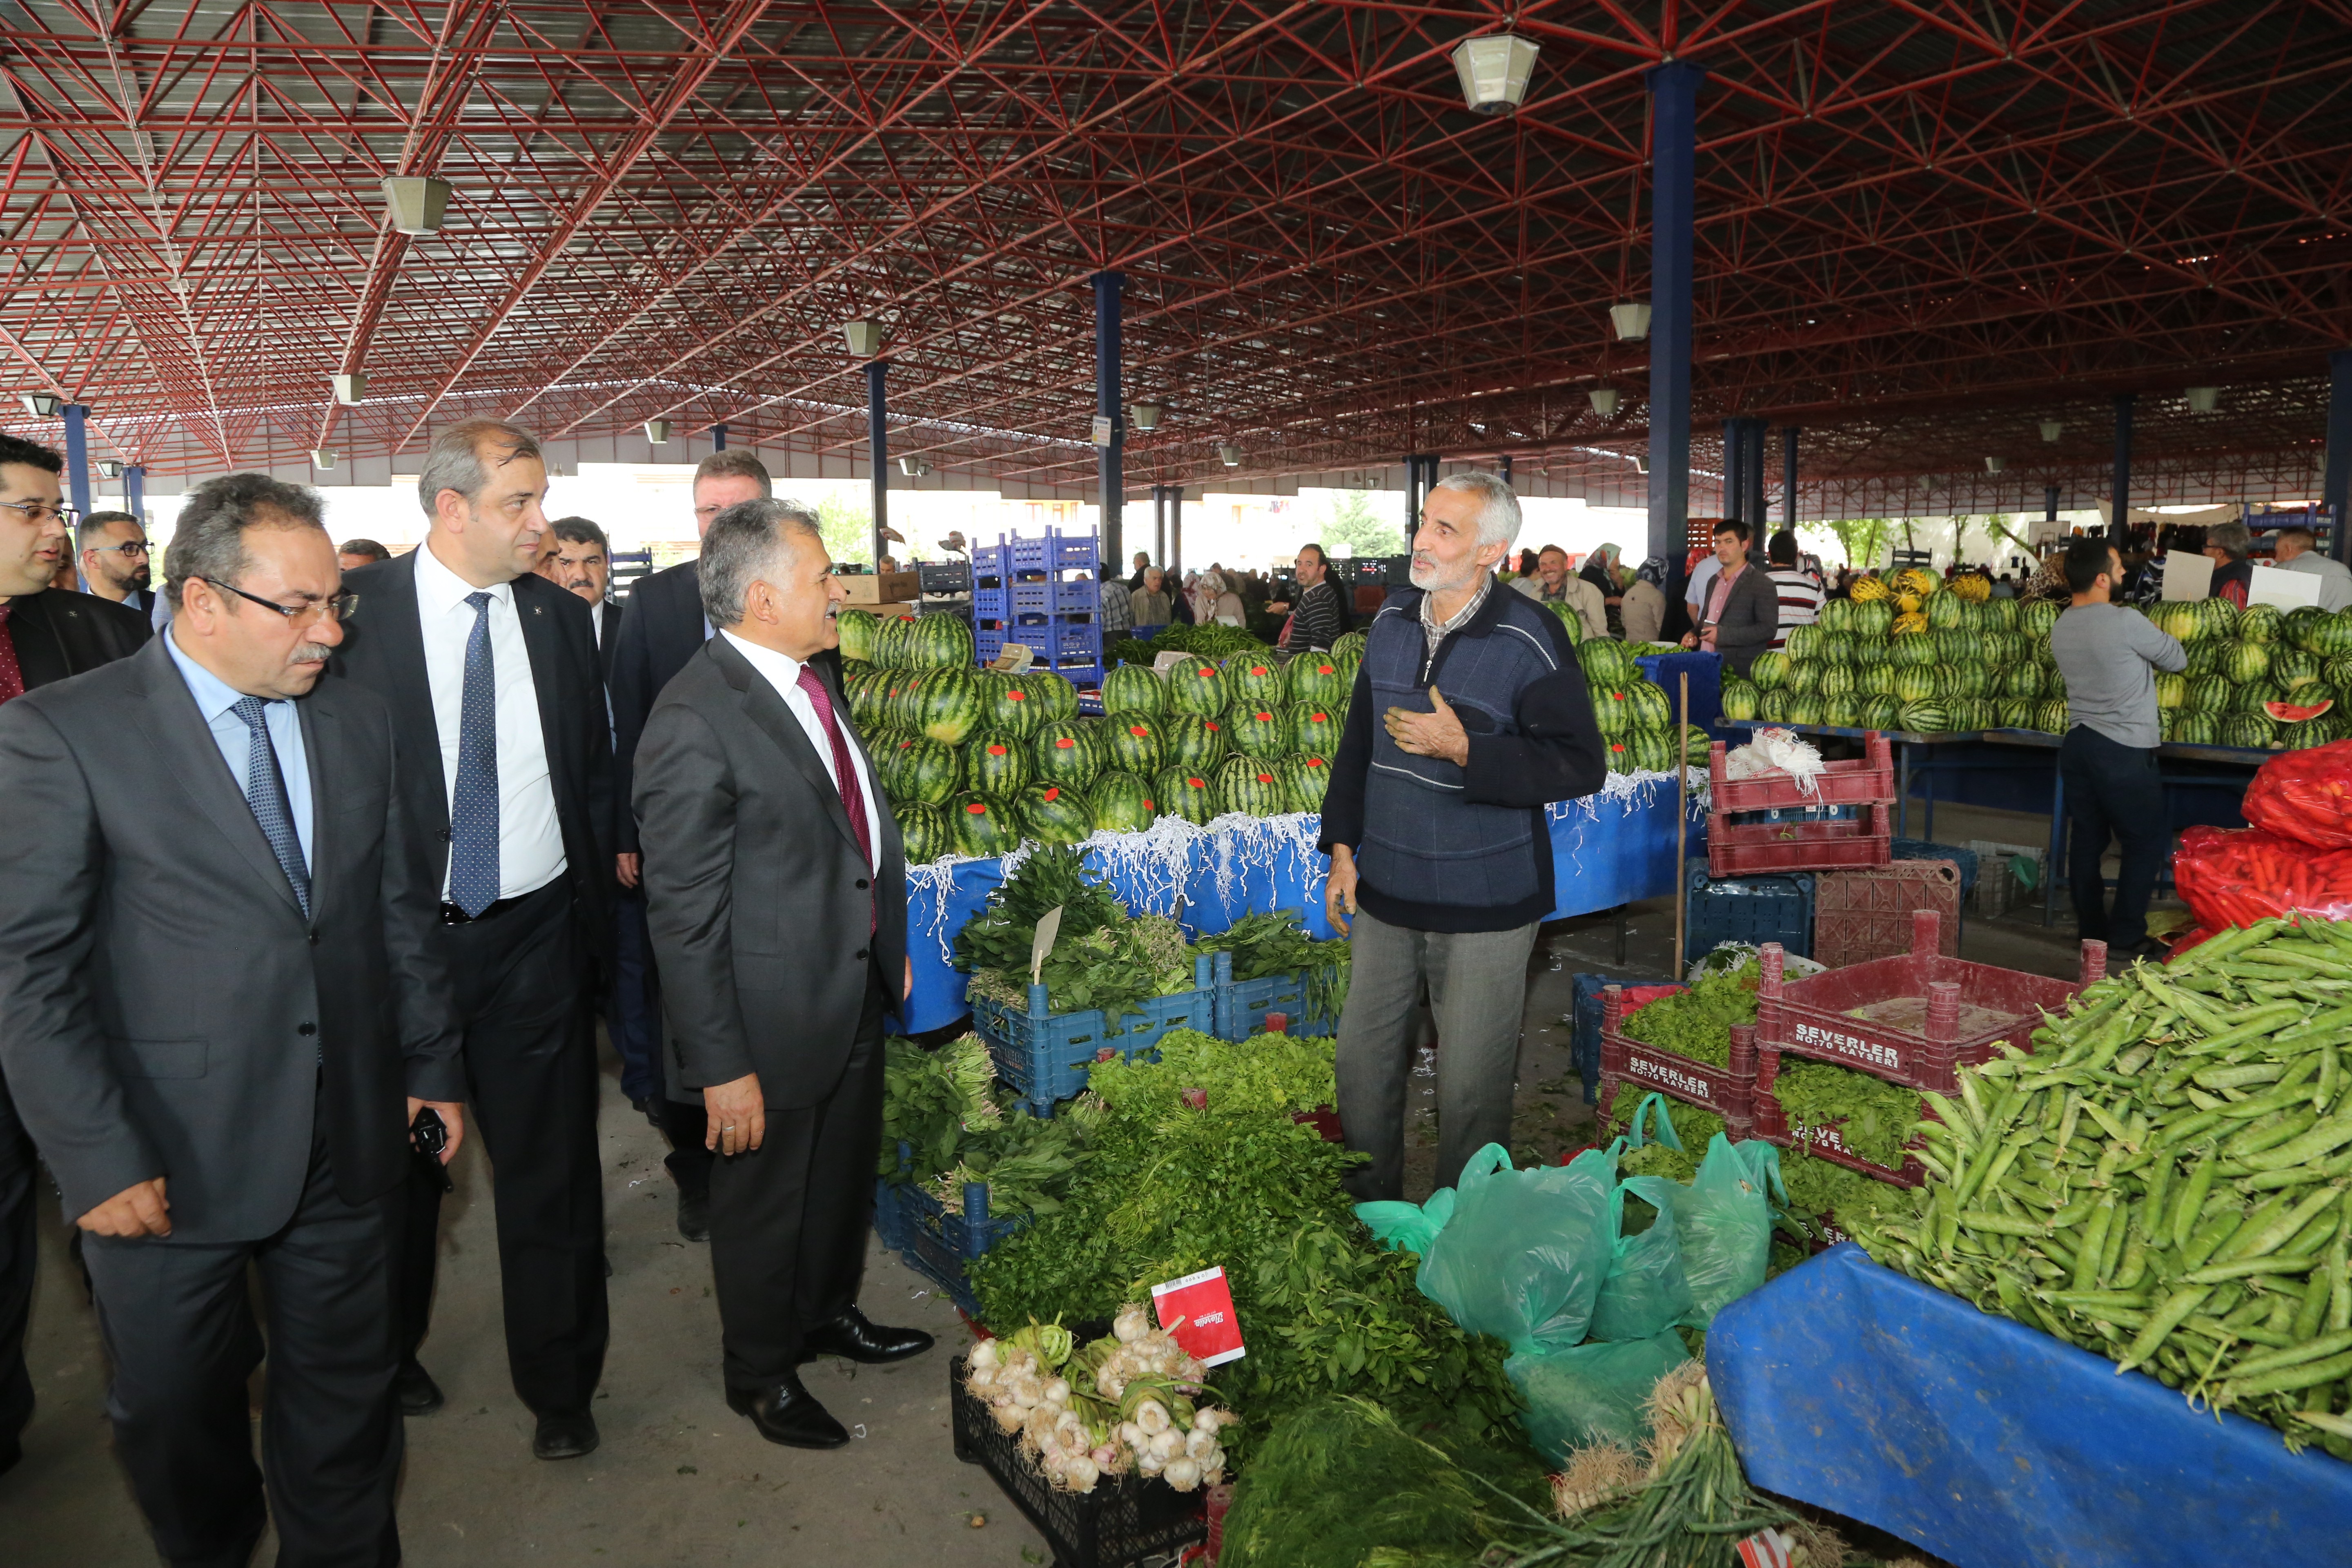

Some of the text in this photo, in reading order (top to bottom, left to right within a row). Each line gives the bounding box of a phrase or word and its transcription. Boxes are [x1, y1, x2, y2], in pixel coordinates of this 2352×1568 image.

[1796, 1034, 1833, 1049] NO:70
[1797, 1023, 1898, 1060] SEVERLER
[1630, 1065, 1659, 1080] NO:70
[1630, 1057, 1708, 1091] SEVERLER
